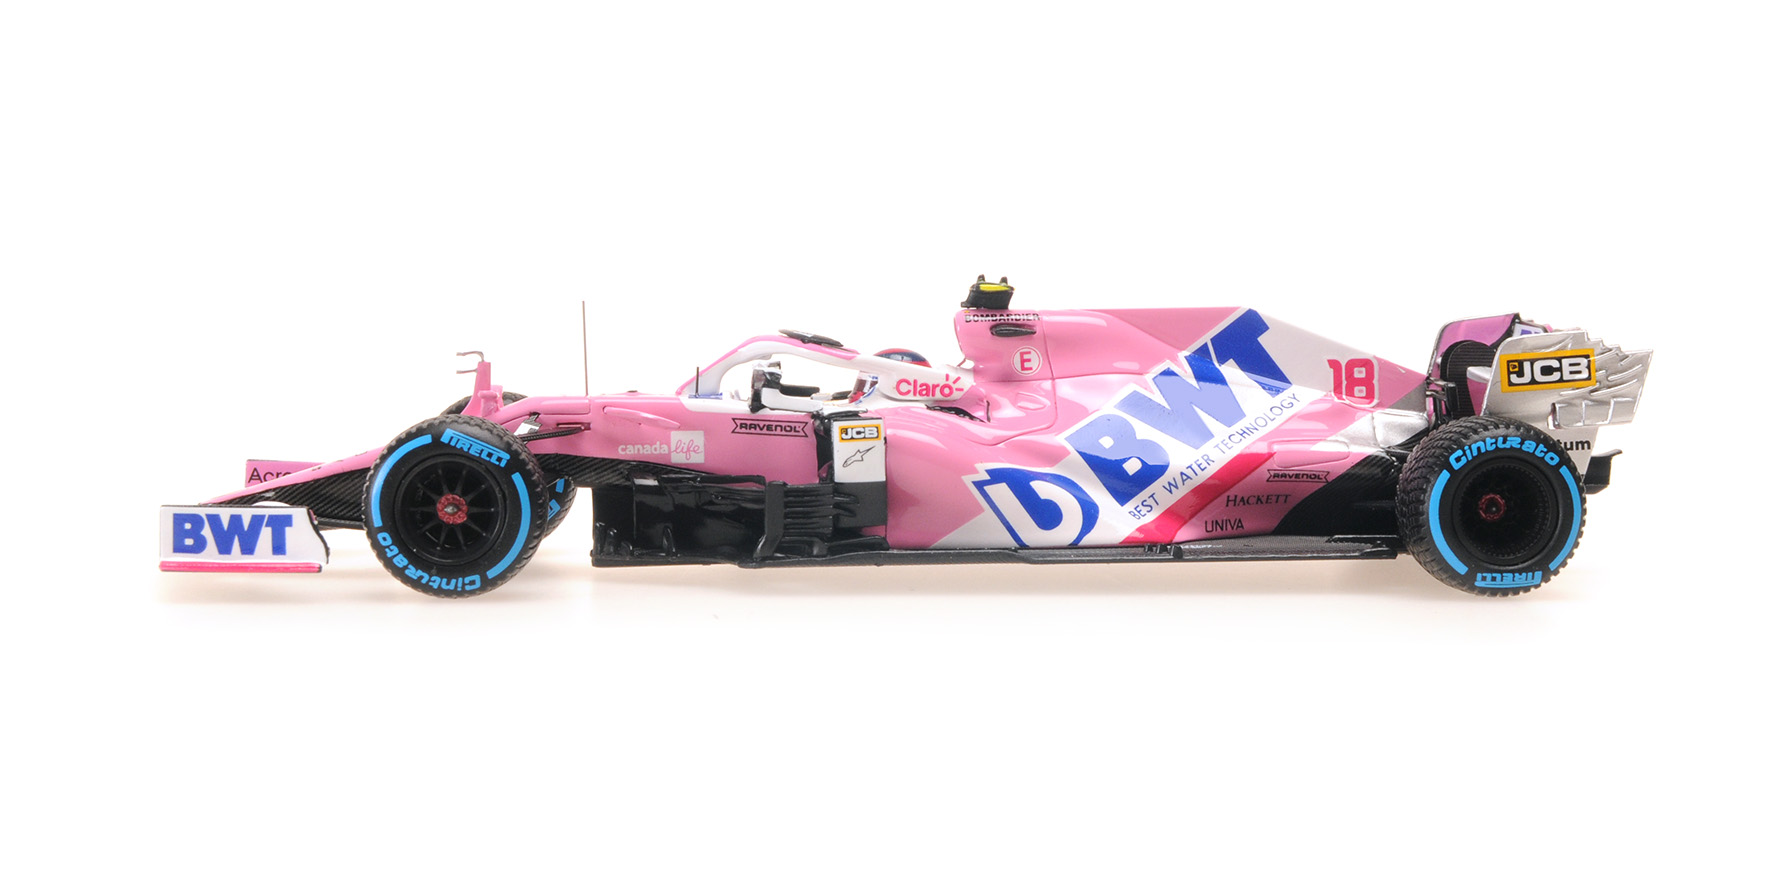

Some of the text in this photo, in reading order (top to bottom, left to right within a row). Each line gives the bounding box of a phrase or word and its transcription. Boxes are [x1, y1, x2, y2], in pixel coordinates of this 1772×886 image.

[964, 313, 1041, 323] BOMBARDIER
[1019, 351, 1034, 371] E
[1509, 357, 1590, 384] JCB
[895, 377, 954, 398] Claro
[1326, 357, 1376, 406] 18
[1064, 308, 1294, 507] BWT
[739, 421, 801, 433] RAVENOL
[841, 427, 879, 440] JCB
[440, 428, 511, 468] PIRELLI
[618, 440, 703, 461] canada life
[1128, 392, 1301, 520] BEST WATER TECHNOLOGY
[1449, 436, 1560, 472] Cinturato
[1225, 494, 1291, 507] HACKETT
[172, 513, 293, 556] BWT
[1204, 518, 1245, 533] UNIVA
[377, 532, 482, 591] Cinturato
[1474, 570, 1542, 588] PIRELLI
